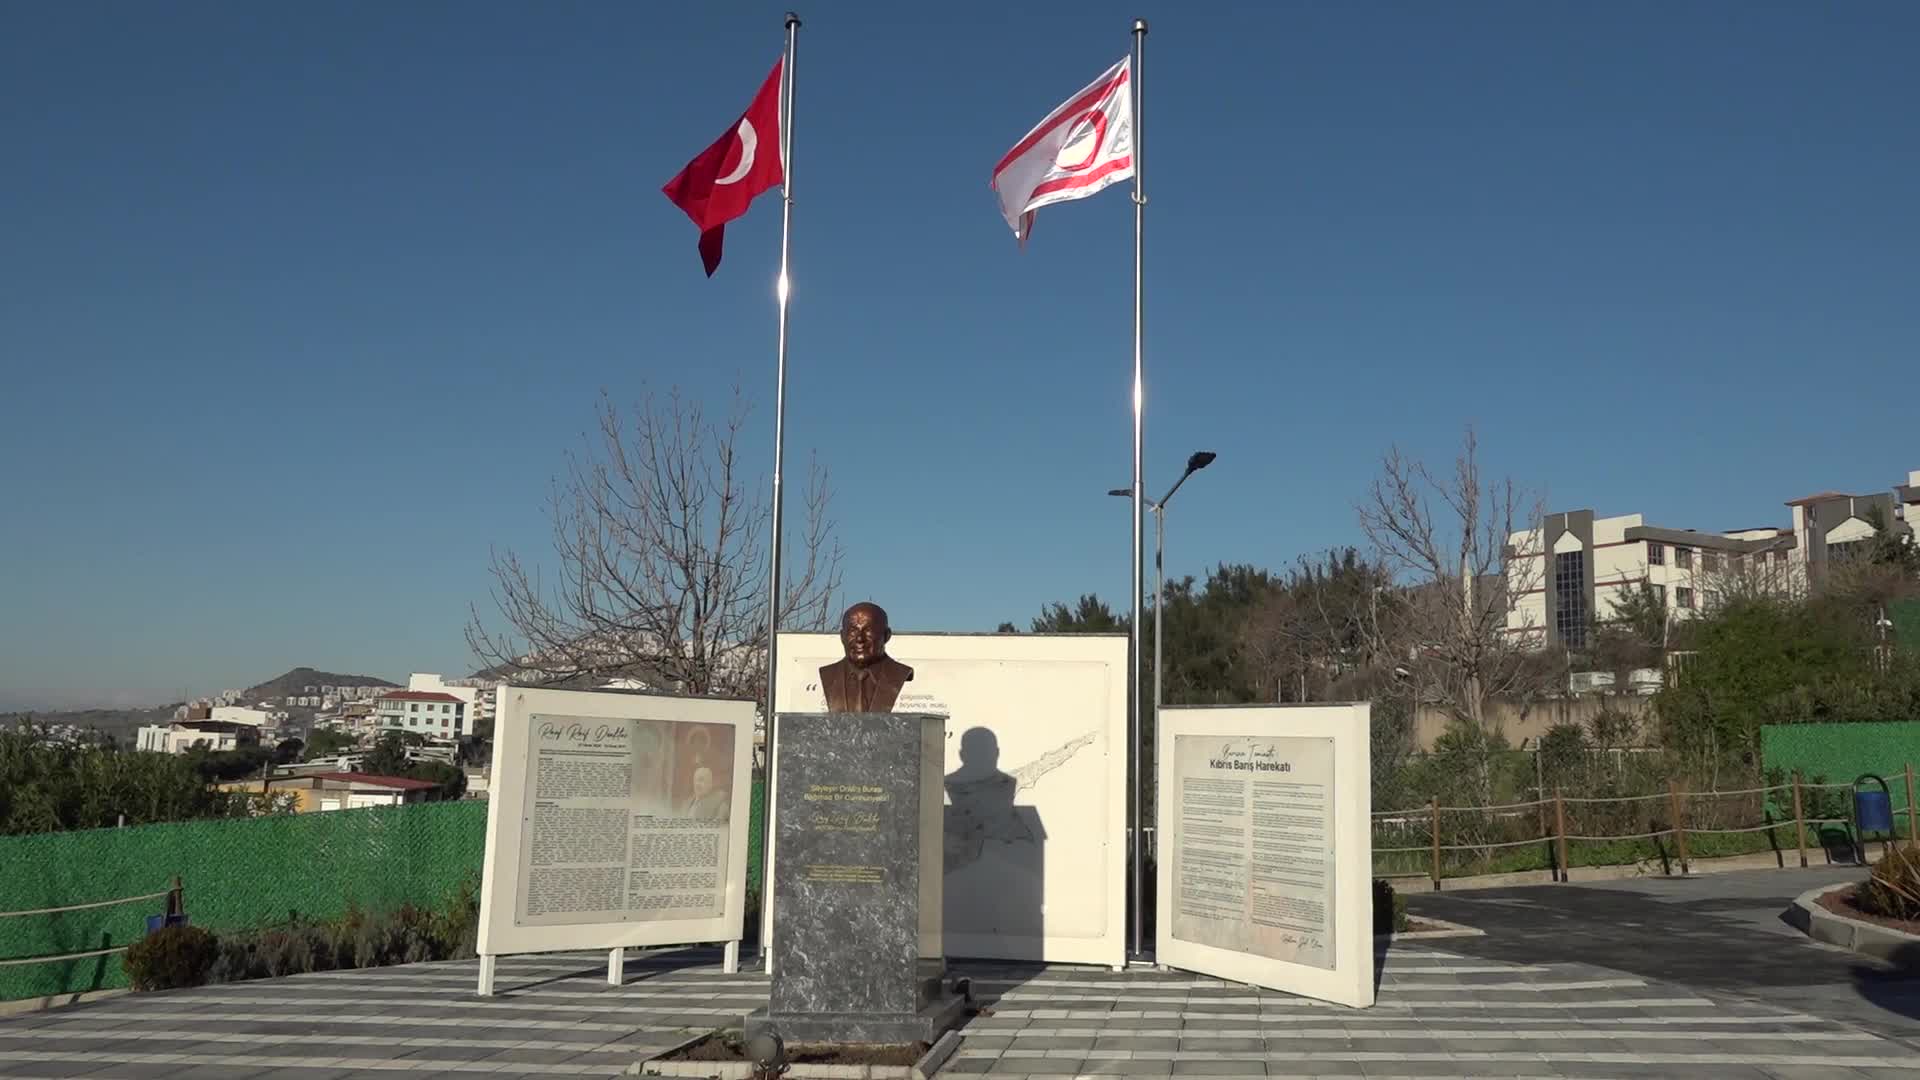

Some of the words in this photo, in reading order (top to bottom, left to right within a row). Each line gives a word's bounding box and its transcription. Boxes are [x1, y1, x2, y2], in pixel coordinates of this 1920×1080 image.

[1210, 760, 1232, 770] Kıbrıs
[1234, 760, 1255, 772] Barış
[1256, 761, 1291, 772] Harekatı
